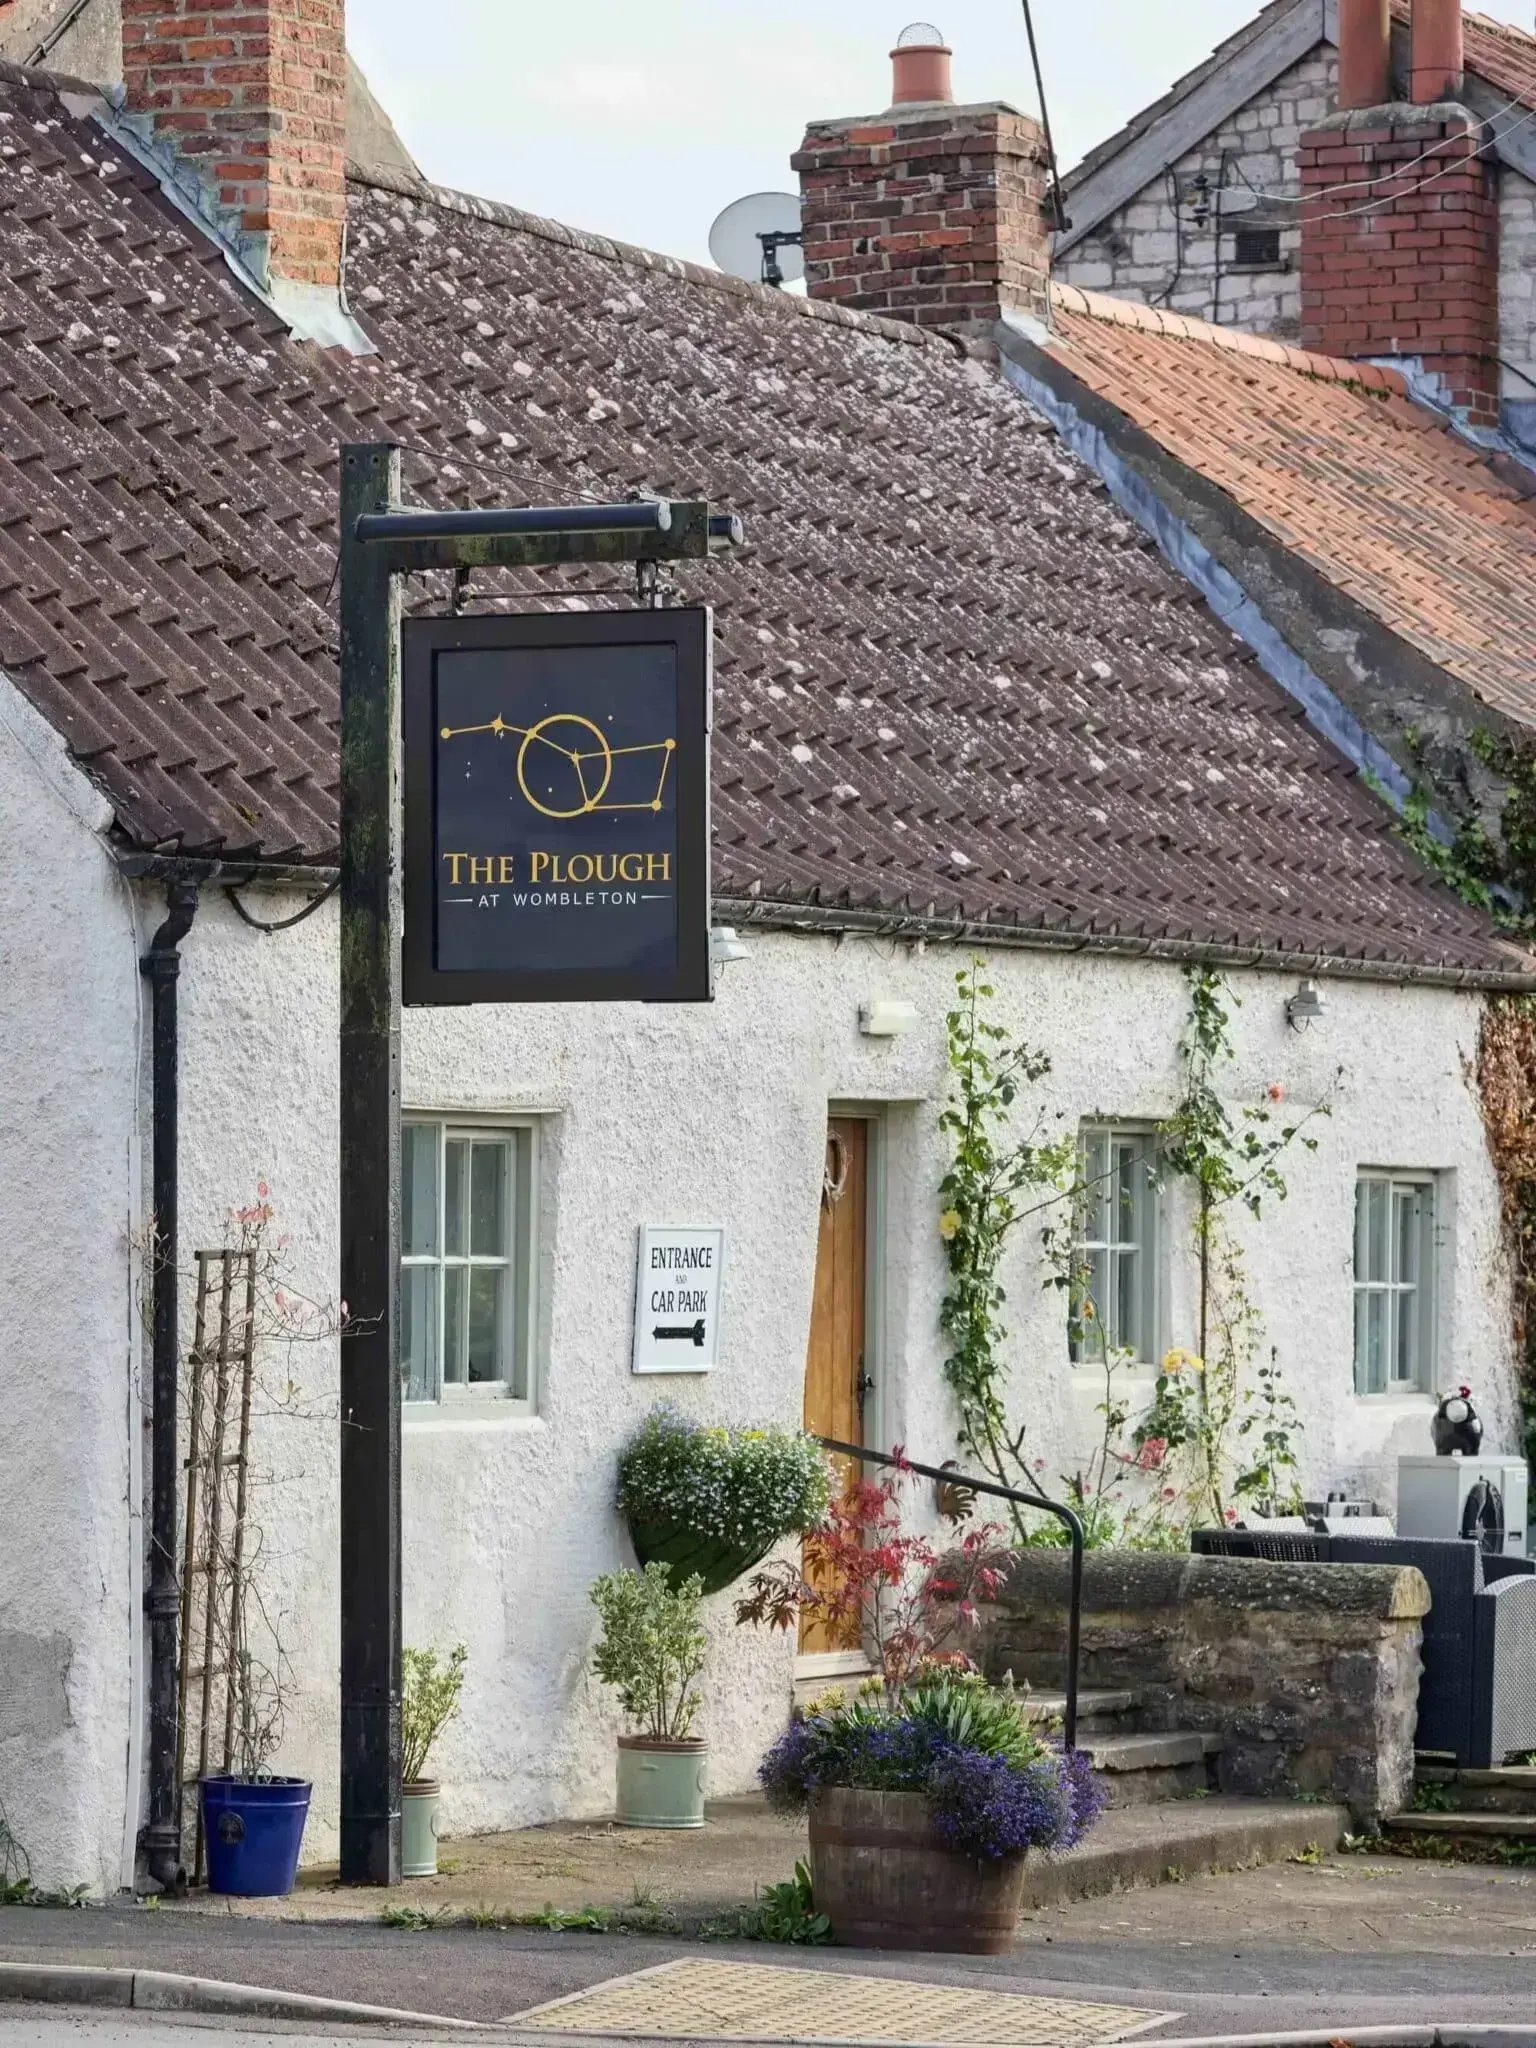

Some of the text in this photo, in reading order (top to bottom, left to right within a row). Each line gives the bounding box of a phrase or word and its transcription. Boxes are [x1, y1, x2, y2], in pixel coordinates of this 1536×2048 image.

[478, 891, 637, 908] AT WOMBLETON
[651, 1247, 712, 1268] ENTRANCE
[651, 1290, 708, 1312] CAR PARK
